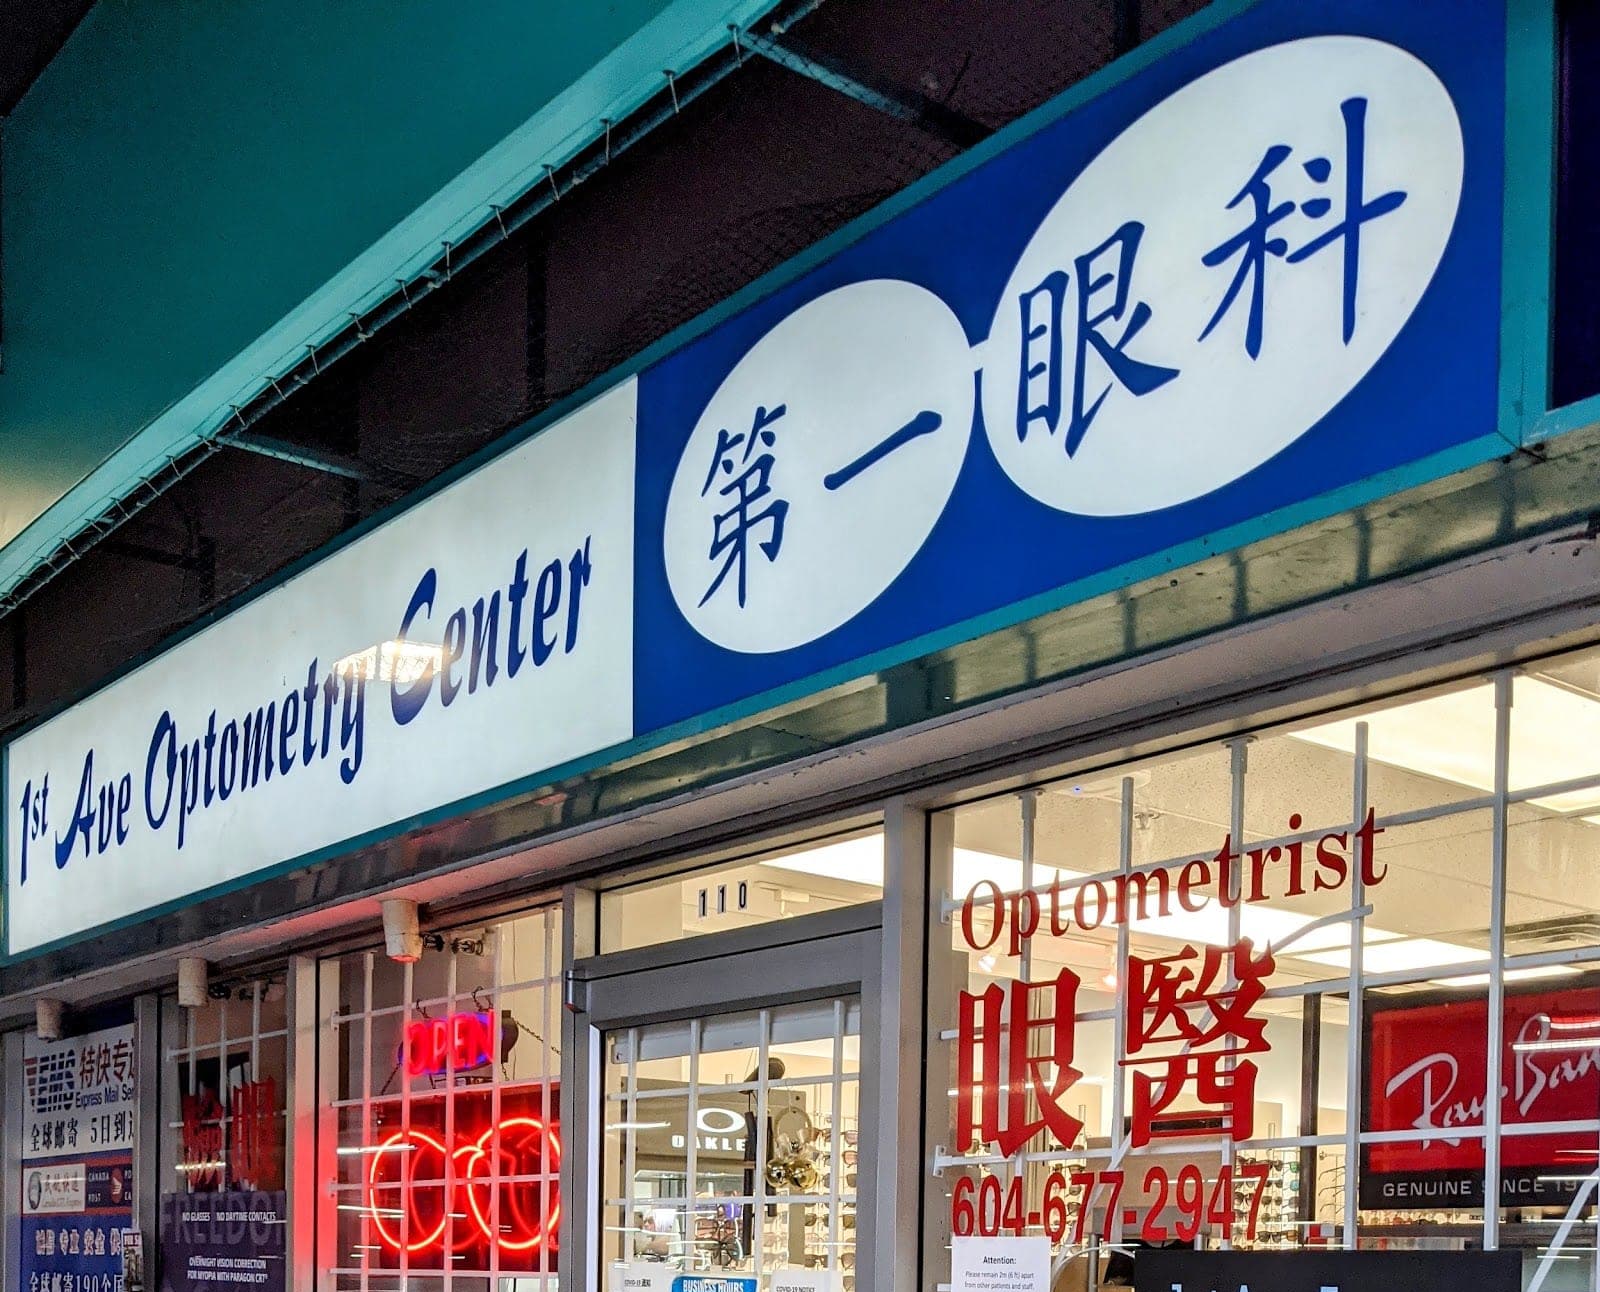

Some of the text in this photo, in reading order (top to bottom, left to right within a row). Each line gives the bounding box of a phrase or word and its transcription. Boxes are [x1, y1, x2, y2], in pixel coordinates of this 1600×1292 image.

[699, 96, 1408, 610] 第一眼科
[19, 535, 592, 886] 1st Ave Optometry Center
[700, 881, 747, 917] 110
[961, 806, 1389, 958] Optometrist
[408, 1010, 496, 1076] OPEN
[956, 935, 1277, 1160] 眼醫
[75, 1091, 103, 1111] Express
[104, 1085, 119, 1105] Mail
[31, 1117, 79, 1152] 全球邮寄
[671, 1134, 747, 1151] OKLE
[952, 1163, 1271, 1245] 604-677-2947
[1383, 1180, 1472, 1197] GENUINE
[183, 1211, 276, 1221] NO GLASSES NO DAYTIME CONTACTS
[187, 1270, 197, 1280] FOR
[197, 1270, 216, 1281] MYOPIA
[217, 1271, 229, 1281] WITH
[230, 1272, 255, 1283] PARAGON
[189, 1257, 267, 1270] OVERNIGHT VISION CORRECTION
[983, 1256, 1017, 1265] Attention:
